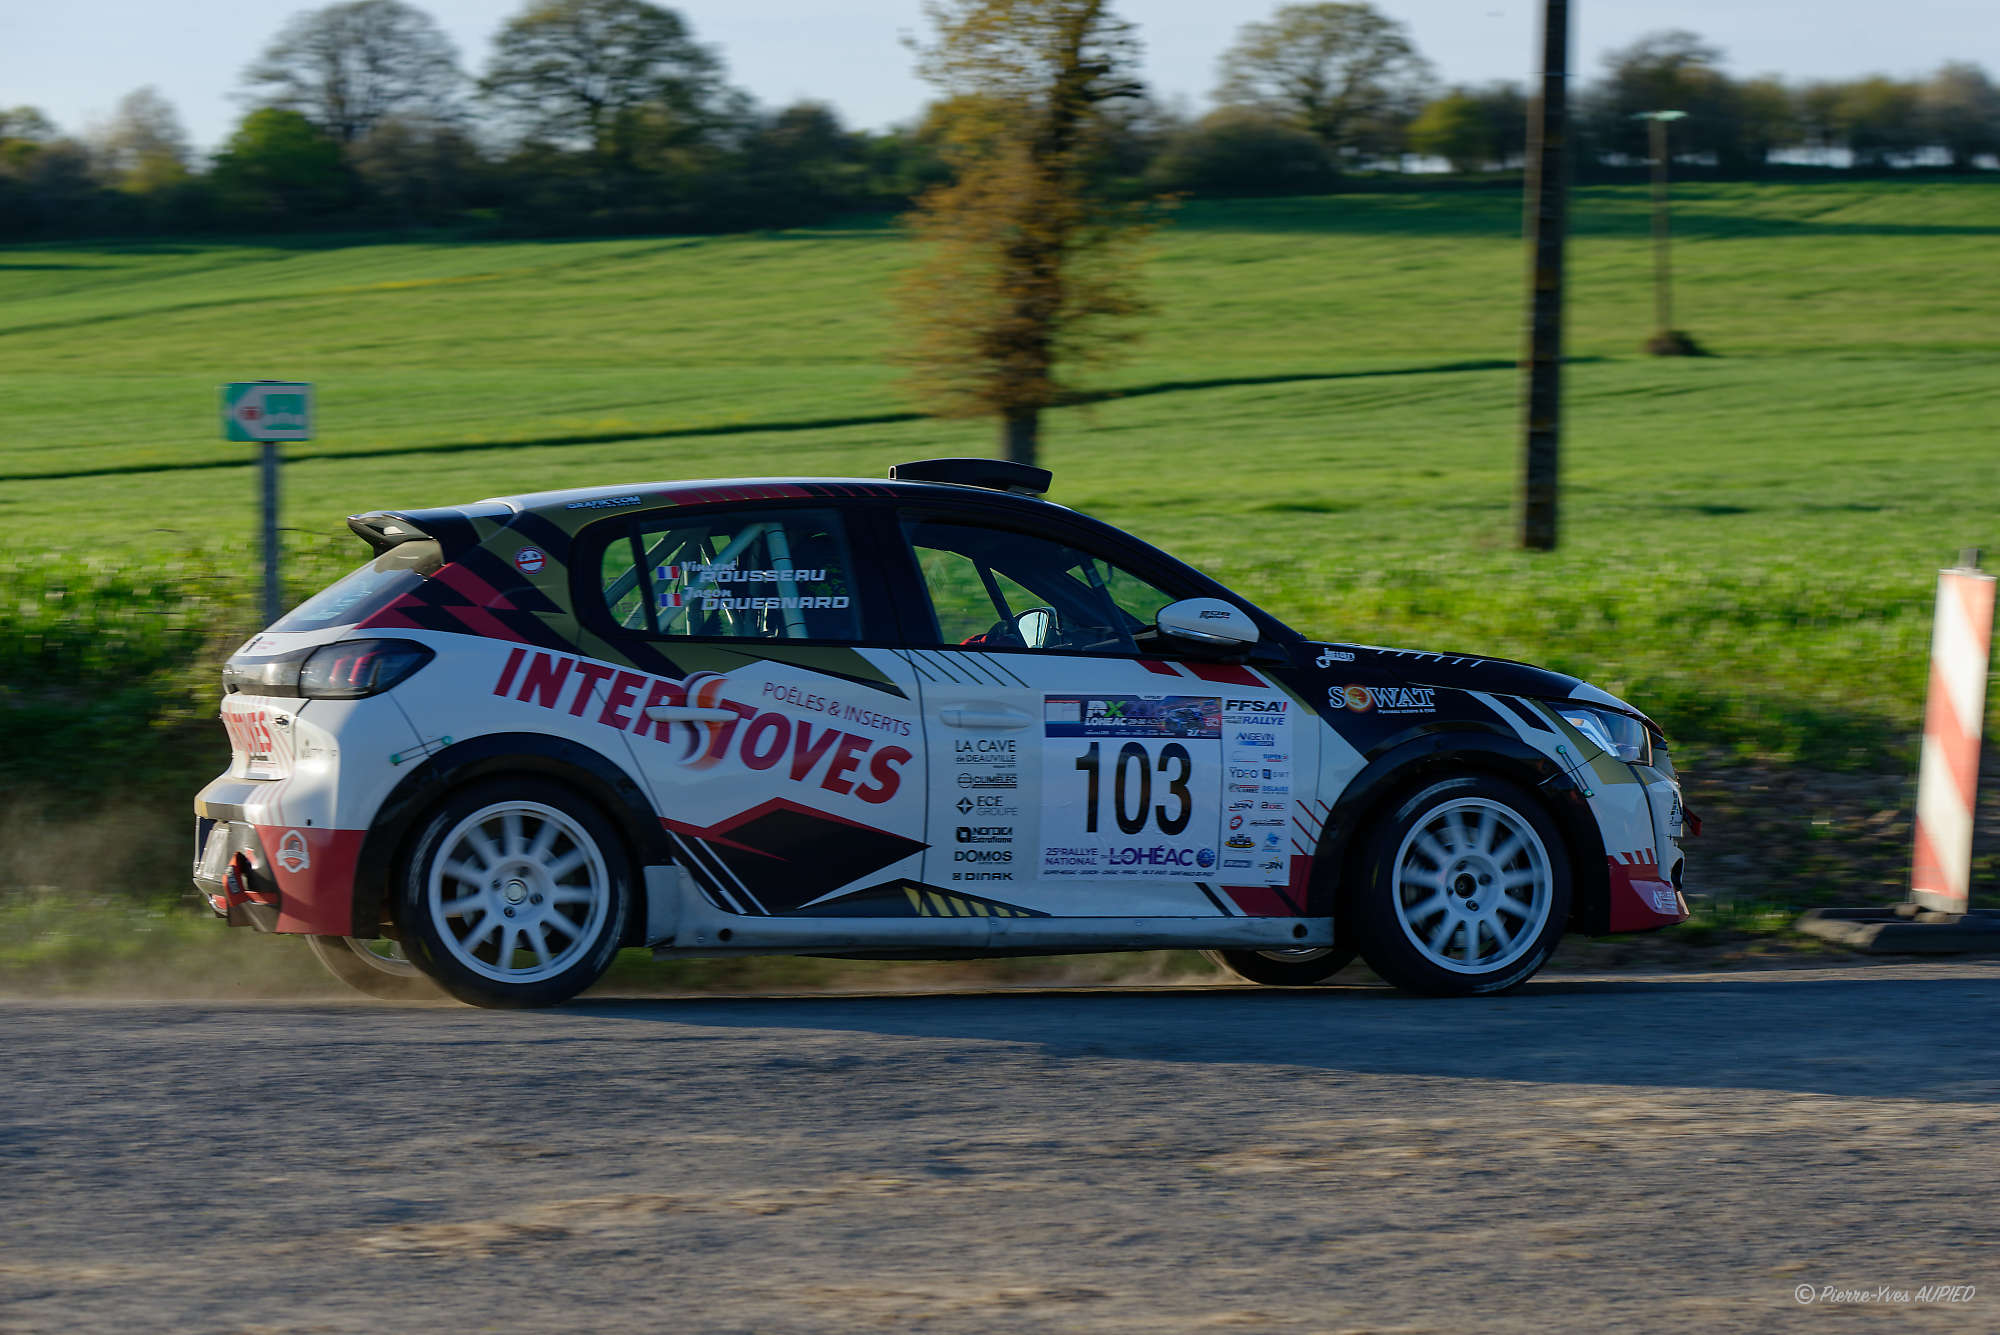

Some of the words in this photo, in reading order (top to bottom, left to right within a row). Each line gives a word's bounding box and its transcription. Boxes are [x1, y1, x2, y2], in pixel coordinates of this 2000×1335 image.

[699, 569, 825, 583] ROUSSEAU
[701, 597, 849, 610] DOUESNARD
[1328, 686, 1435, 709] SOWAT
[828, 701, 841, 717] &
[843, 705, 912, 736] INSERTS
[1242, 716, 1285, 725] RALLYE
[955, 740, 973, 752] LA
[977, 739, 1016, 752] CAVE
[1075, 741, 1192, 836] 103
[954, 850, 1013, 862] DOMOS
[1045, 857, 1097, 865] NATIONAL
[1109, 845, 1194, 867] LOHÉAC
